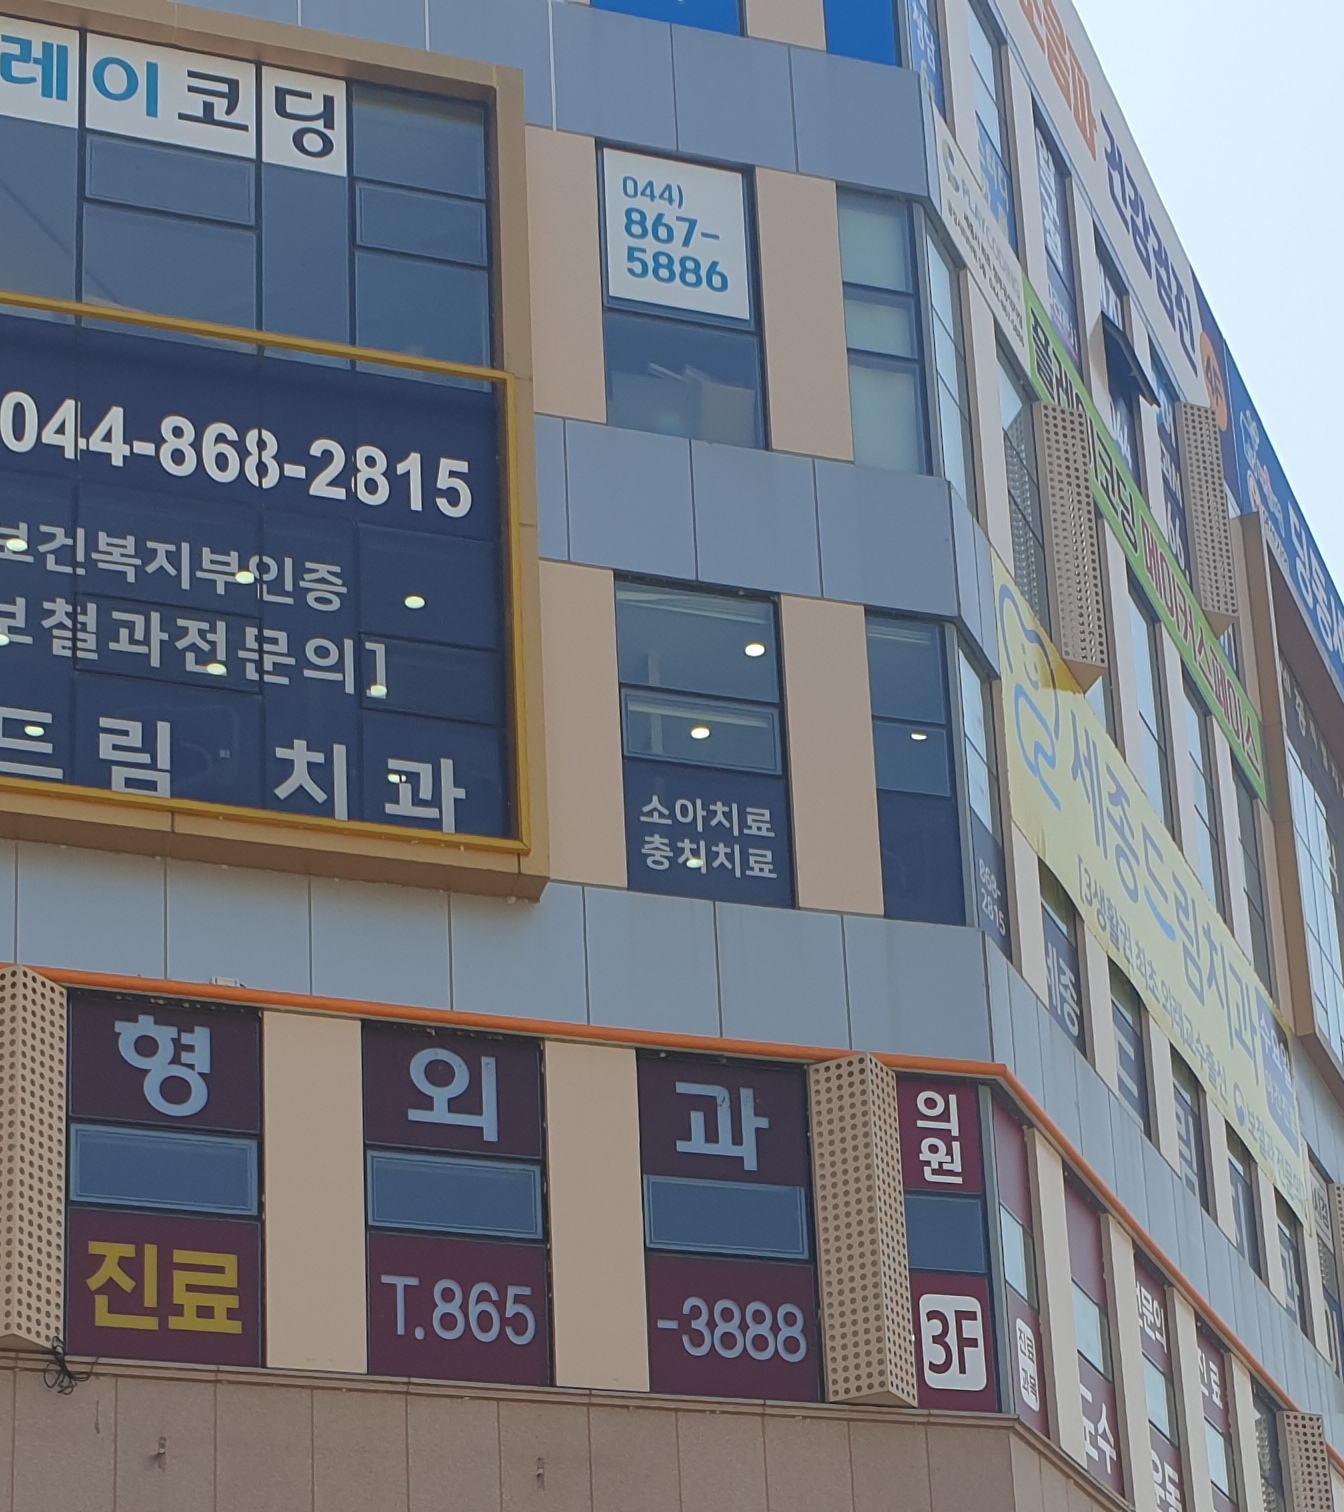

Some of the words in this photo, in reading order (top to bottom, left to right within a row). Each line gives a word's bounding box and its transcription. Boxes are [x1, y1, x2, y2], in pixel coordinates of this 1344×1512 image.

[622, 176, 684, 209] 044)
[624, 208, 719, 249] 867-
[1100, 109, 1198, 378] 건강검진
[625, 251, 730, 294] 5886
[1030, 307, 1139, 556] 플레이코딩
[1140, 514, 1263, 782] 메이커스페이스
[274, 740, 466, 834] 치과
[639, 796, 777, 840] 소아치료
[639, 834, 778, 881] 충치치료
[980, 886, 1006, 940] 2815
[1065, 694, 1263, 1096] 세종드림치과
[914, 1090, 962, 1184] 의원
[86, 1240, 243, 1335] 진료
[923, 1308, 982, 1378] 3F
[1017, 1324, 1036, 1360] 진료
